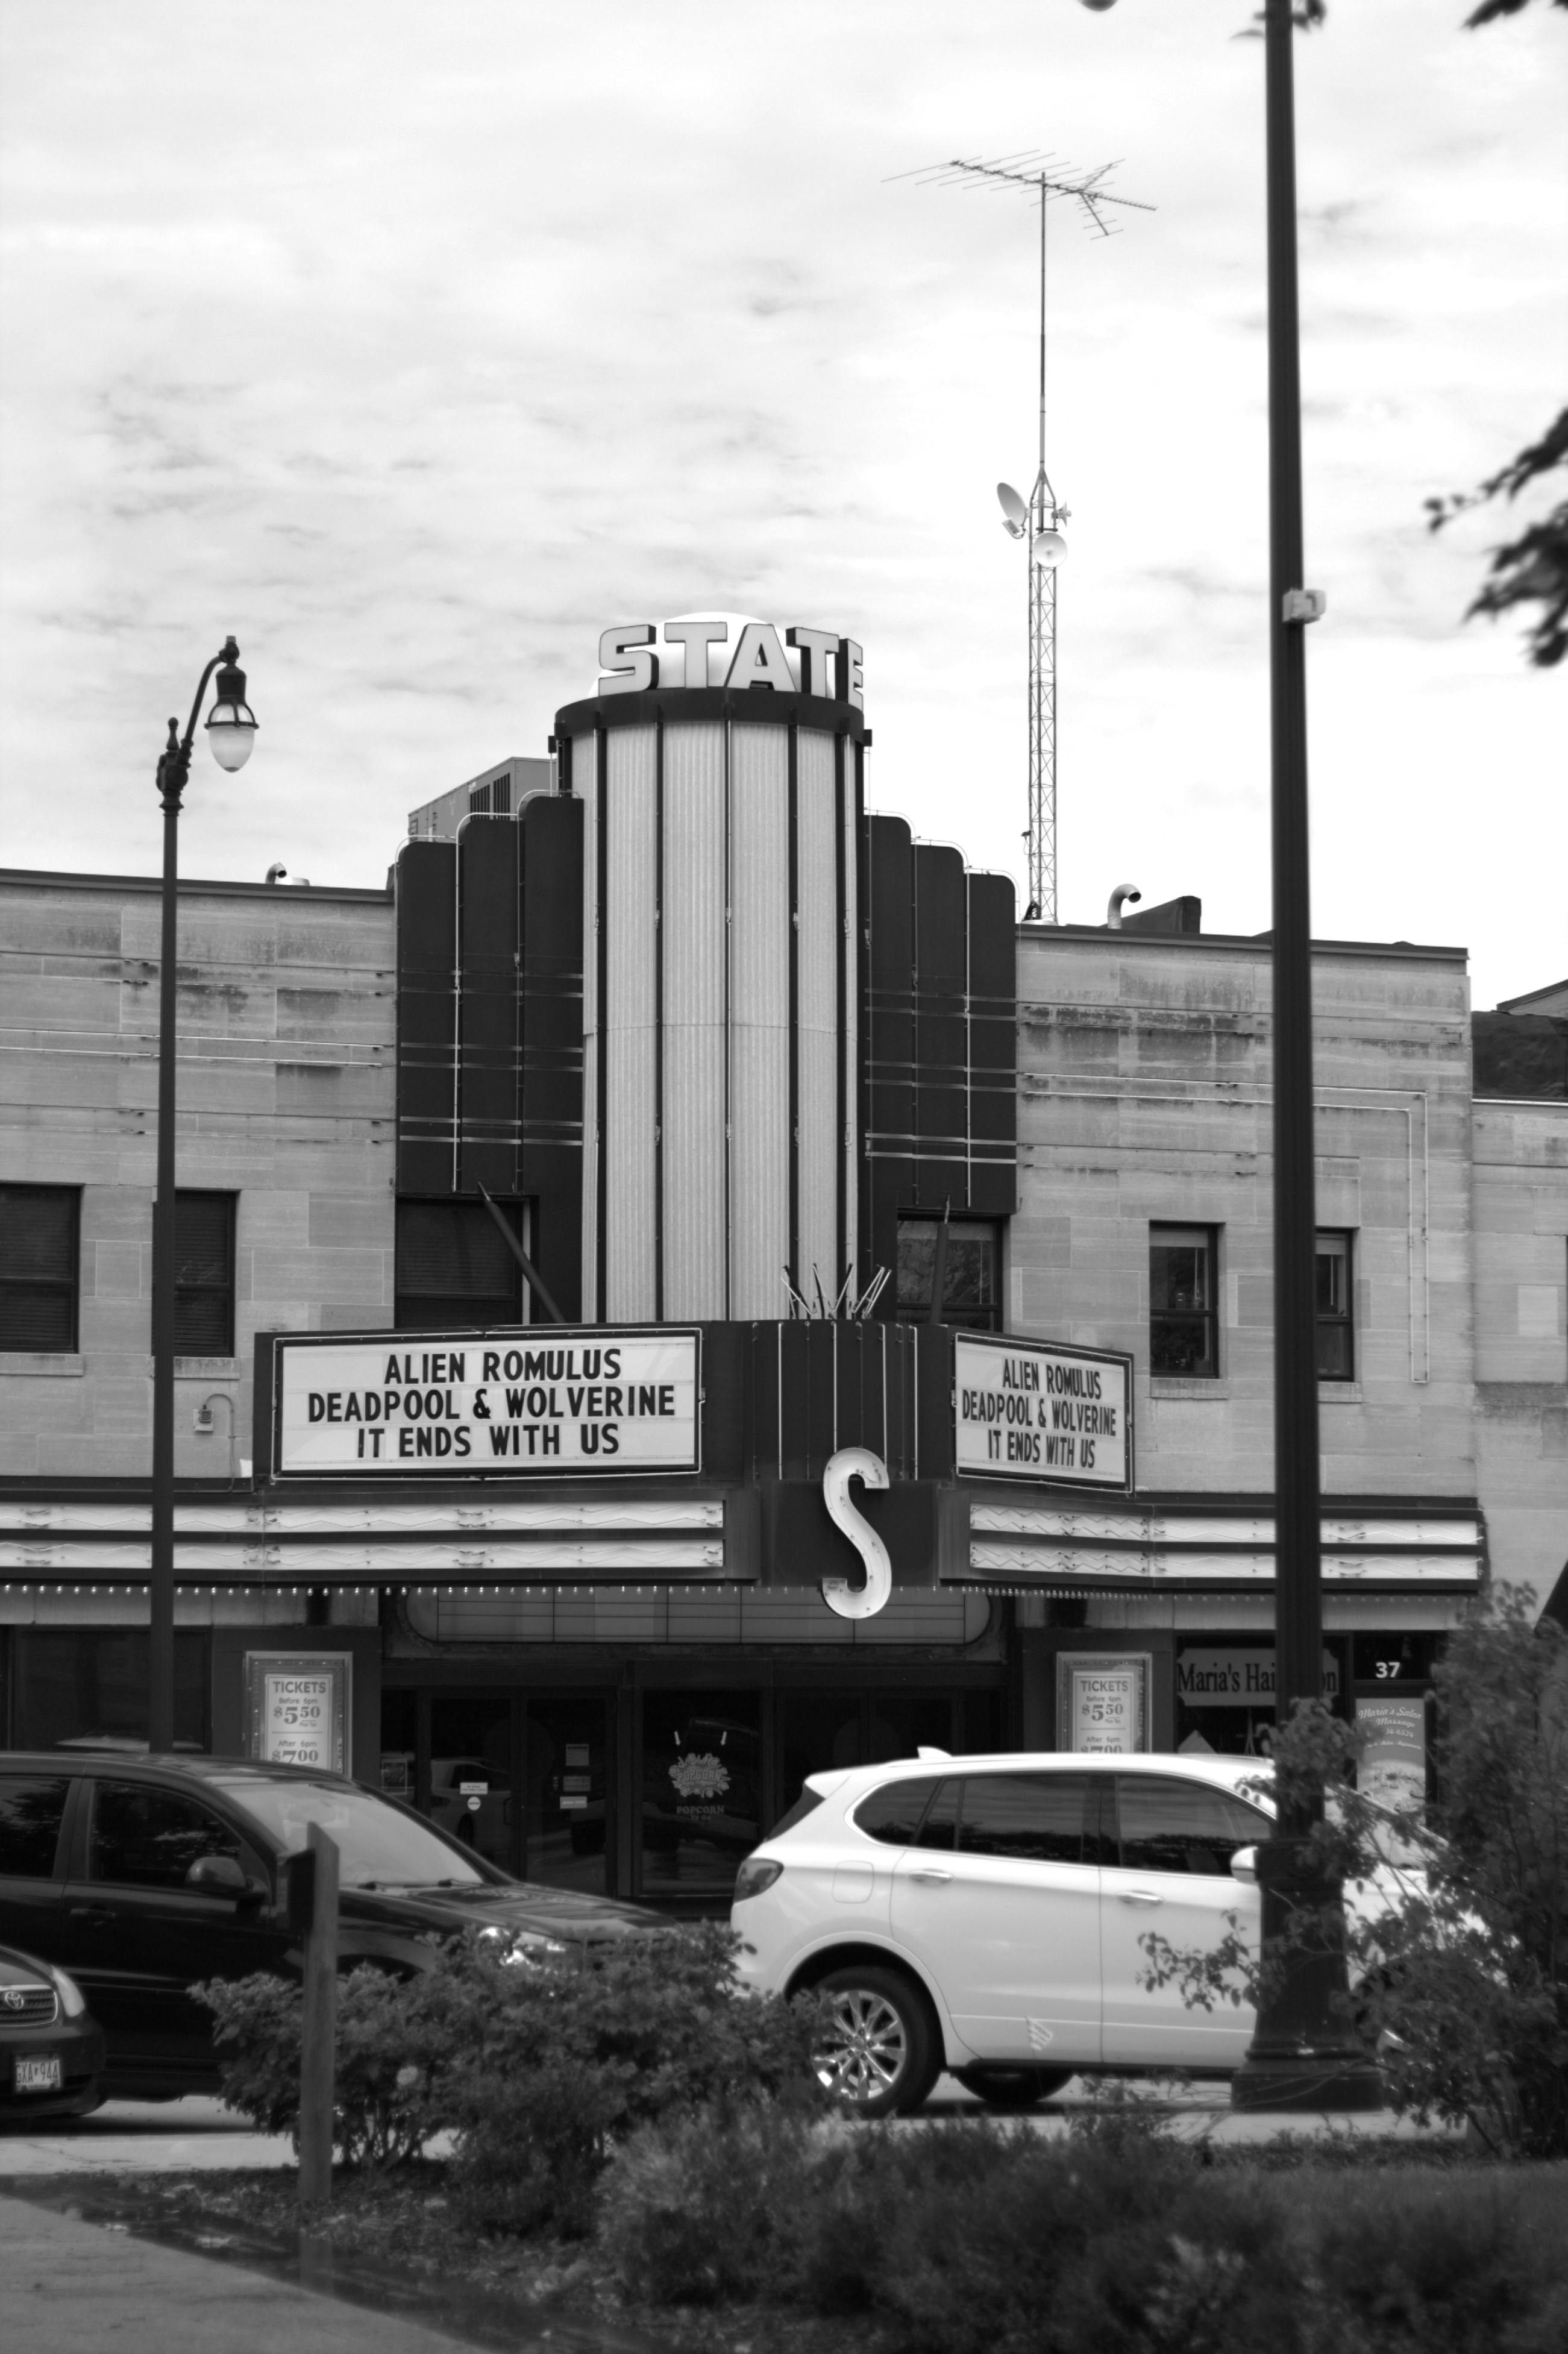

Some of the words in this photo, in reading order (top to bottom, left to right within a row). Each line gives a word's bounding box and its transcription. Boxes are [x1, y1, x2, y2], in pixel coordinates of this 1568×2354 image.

[598, 621, 864, 713] STATE
[384, 1352, 465, 1384] ALIEN
[483, 1349, 621, 1381] ROMULUS
[1003, 1358, 1040, 1392] ALIEN
[1046, 1364, 1102, 1400] ROMULUS
[308, 1389, 460, 1422] DEADPOOL
[472, 1389, 491, 1420] &
[505, 1385, 675, 1418] WOLVERINE
[962, 1389, 1032, 1427] DEADPOOL
[1038, 1398, 1046, 1428] &
[1052, 1400, 1116, 1437] WOLVERINE
[357, 1428, 384, 1458] IT
[398, 1425, 471, 1457] ENDS
[489, 1424, 560, 1456] WITH
[580, 1423, 619, 1454] US
[988, 1429, 1002, 1459] IT
[1008, 1431, 1041, 1463] ENDS
[1046, 1435, 1075, 1466] WITH
[1080, 1439, 1096, 1468] US
[822, 1447, 892, 1619] S
[1177, 1662, 1240, 1692] Maria's
[1245, 1662, 1276, 1692] Hai
[1375, 1662, 1400, 1678] 37
[273, 1681, 327, 1694] TICKETS
[1080, 1680, 1129, 1692] TICKETS
[1358, 1706, 1395, 1719] Maria's
[1396, 1706, 1423, 1720] Salon
[1375, 1717, 1416, 1728] Massage
[677, 1768, 721, 1782] POPCORN
[676, 1805, 725, 1814] POPCORN
[16, 2063, 33, 2083] GXA
